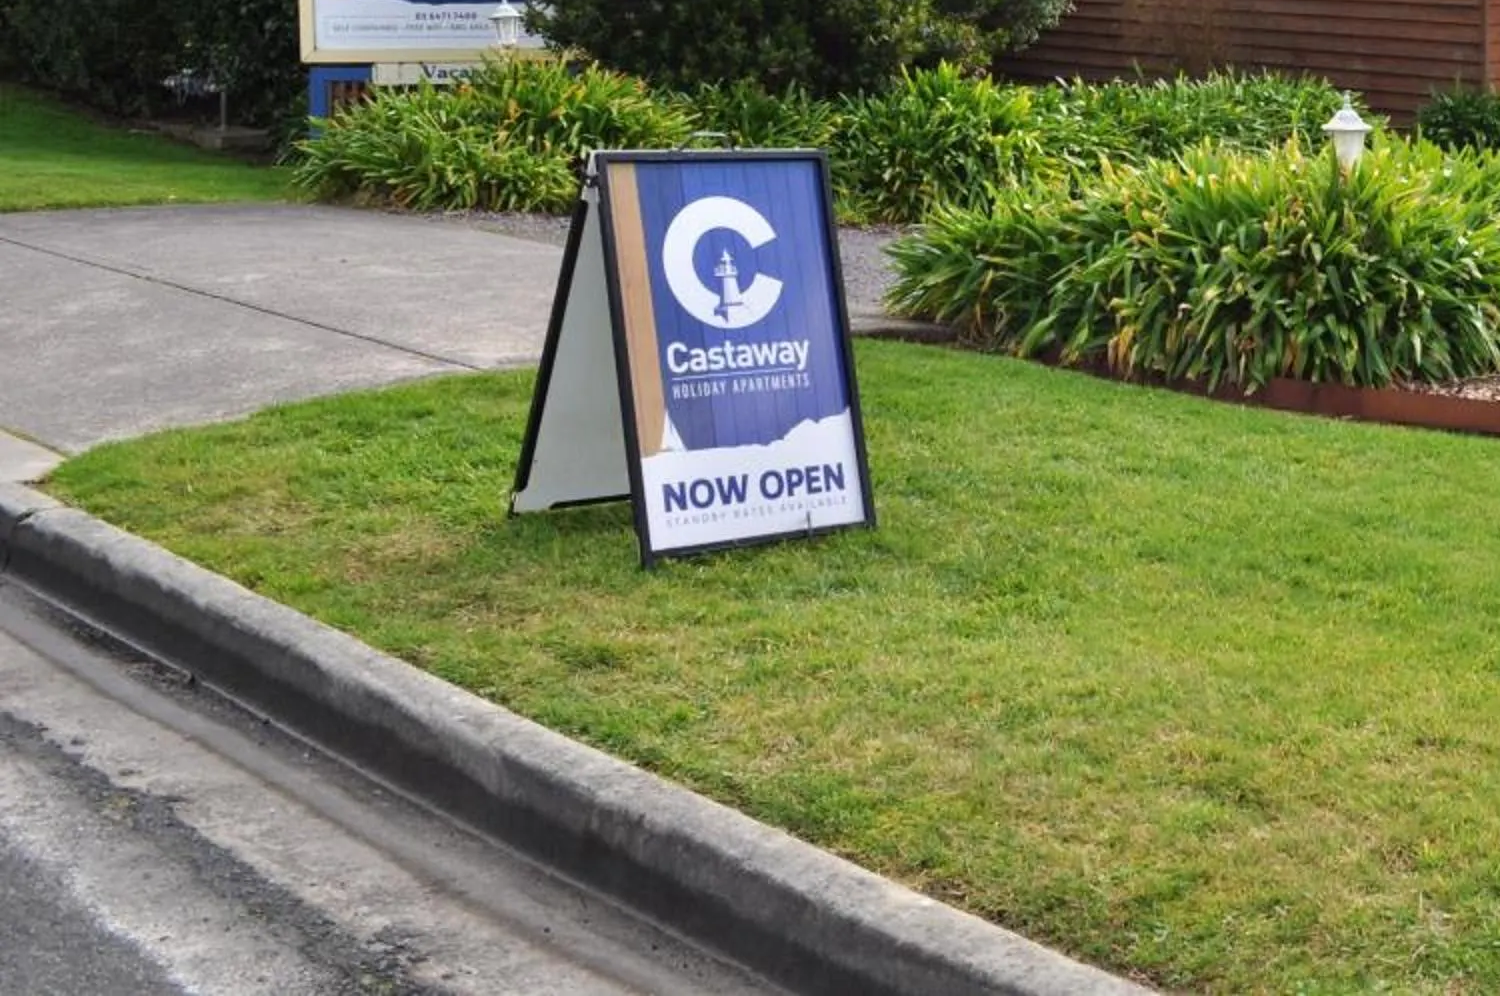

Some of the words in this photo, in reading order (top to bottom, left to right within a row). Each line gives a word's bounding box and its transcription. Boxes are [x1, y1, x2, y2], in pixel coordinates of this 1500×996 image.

[421, 64, 476, 79] Vaca
[666, 339, 809, 374] Castaway
[672, 380, 726, 400] HOLIDAY
[732, 373, 810, 395] APARTMENTS
[662, 474, 748, 513] NOW
[759, 462, 845, 501] OPEN
[665, 509, 726, 528] STANDBY
